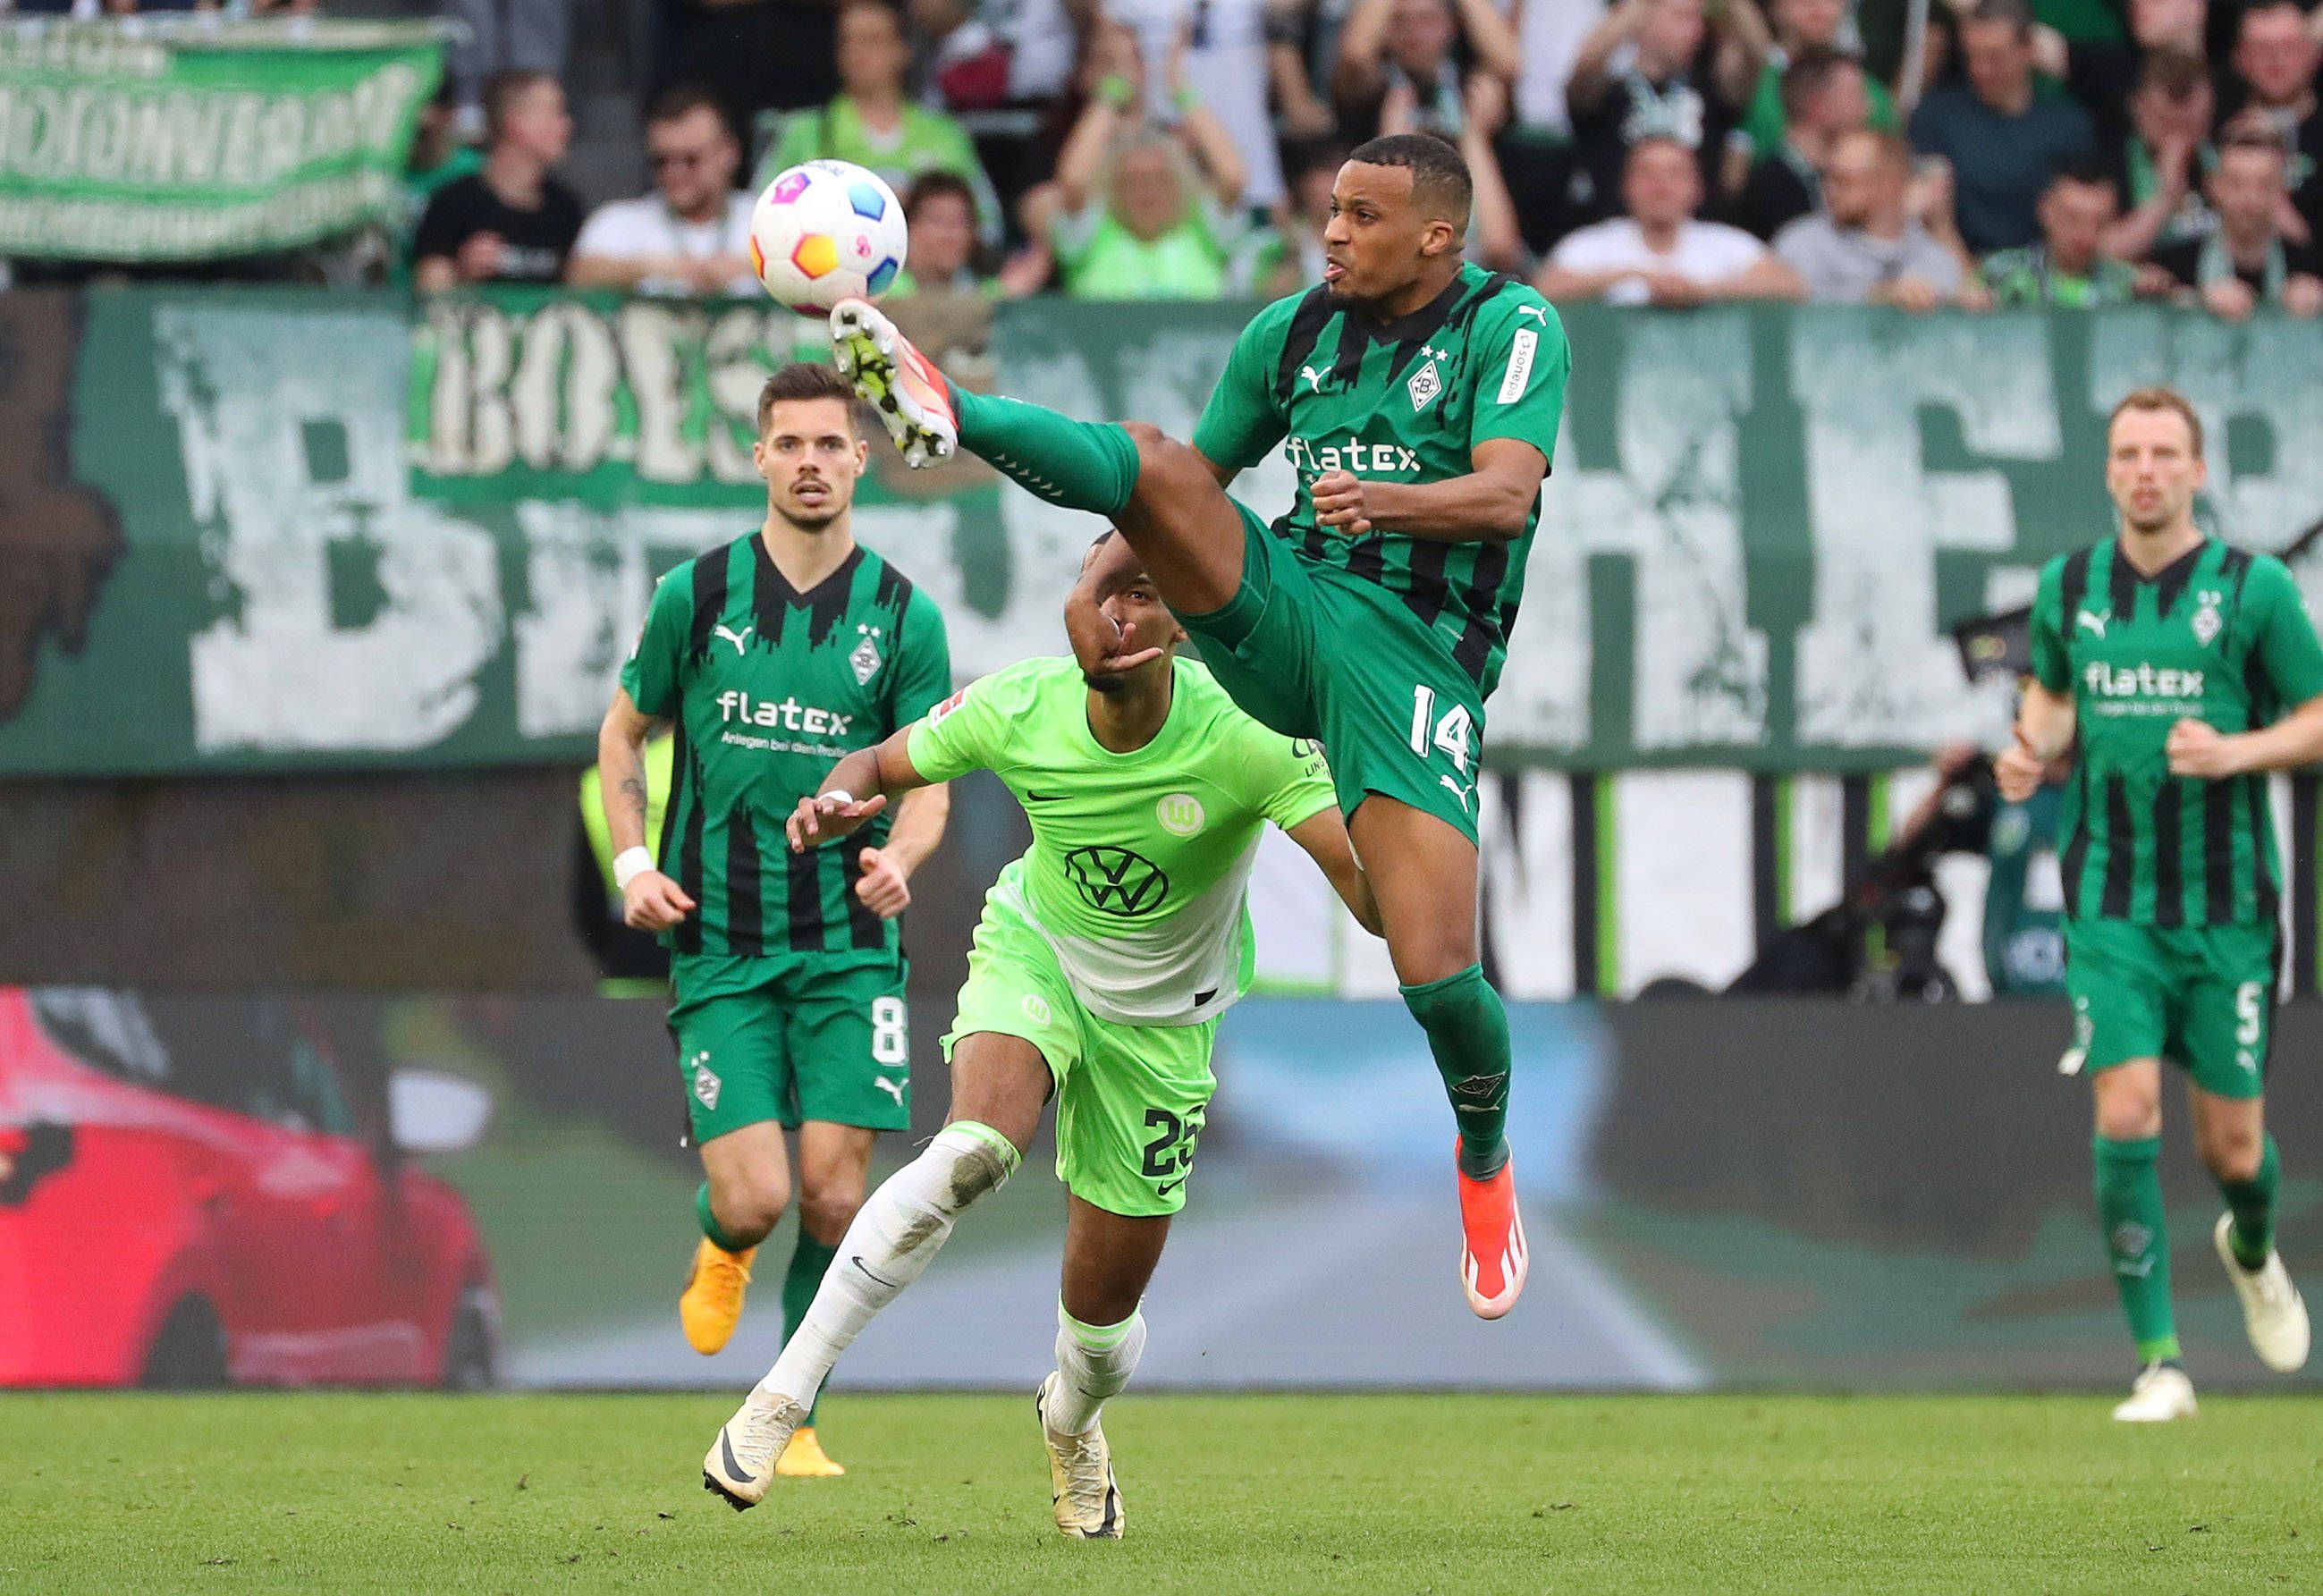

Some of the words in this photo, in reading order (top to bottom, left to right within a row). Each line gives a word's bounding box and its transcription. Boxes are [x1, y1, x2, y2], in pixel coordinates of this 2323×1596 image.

[1286, 435, 1422, 472] flatex
[2084, 661, 2205, 697] flatex
[715, 689, 853, 737] flatex
[1410, 683, 1473, 776] 14
[871, 995, 909, 1067] 8
[2236, 980, 2264, 1045] 5
